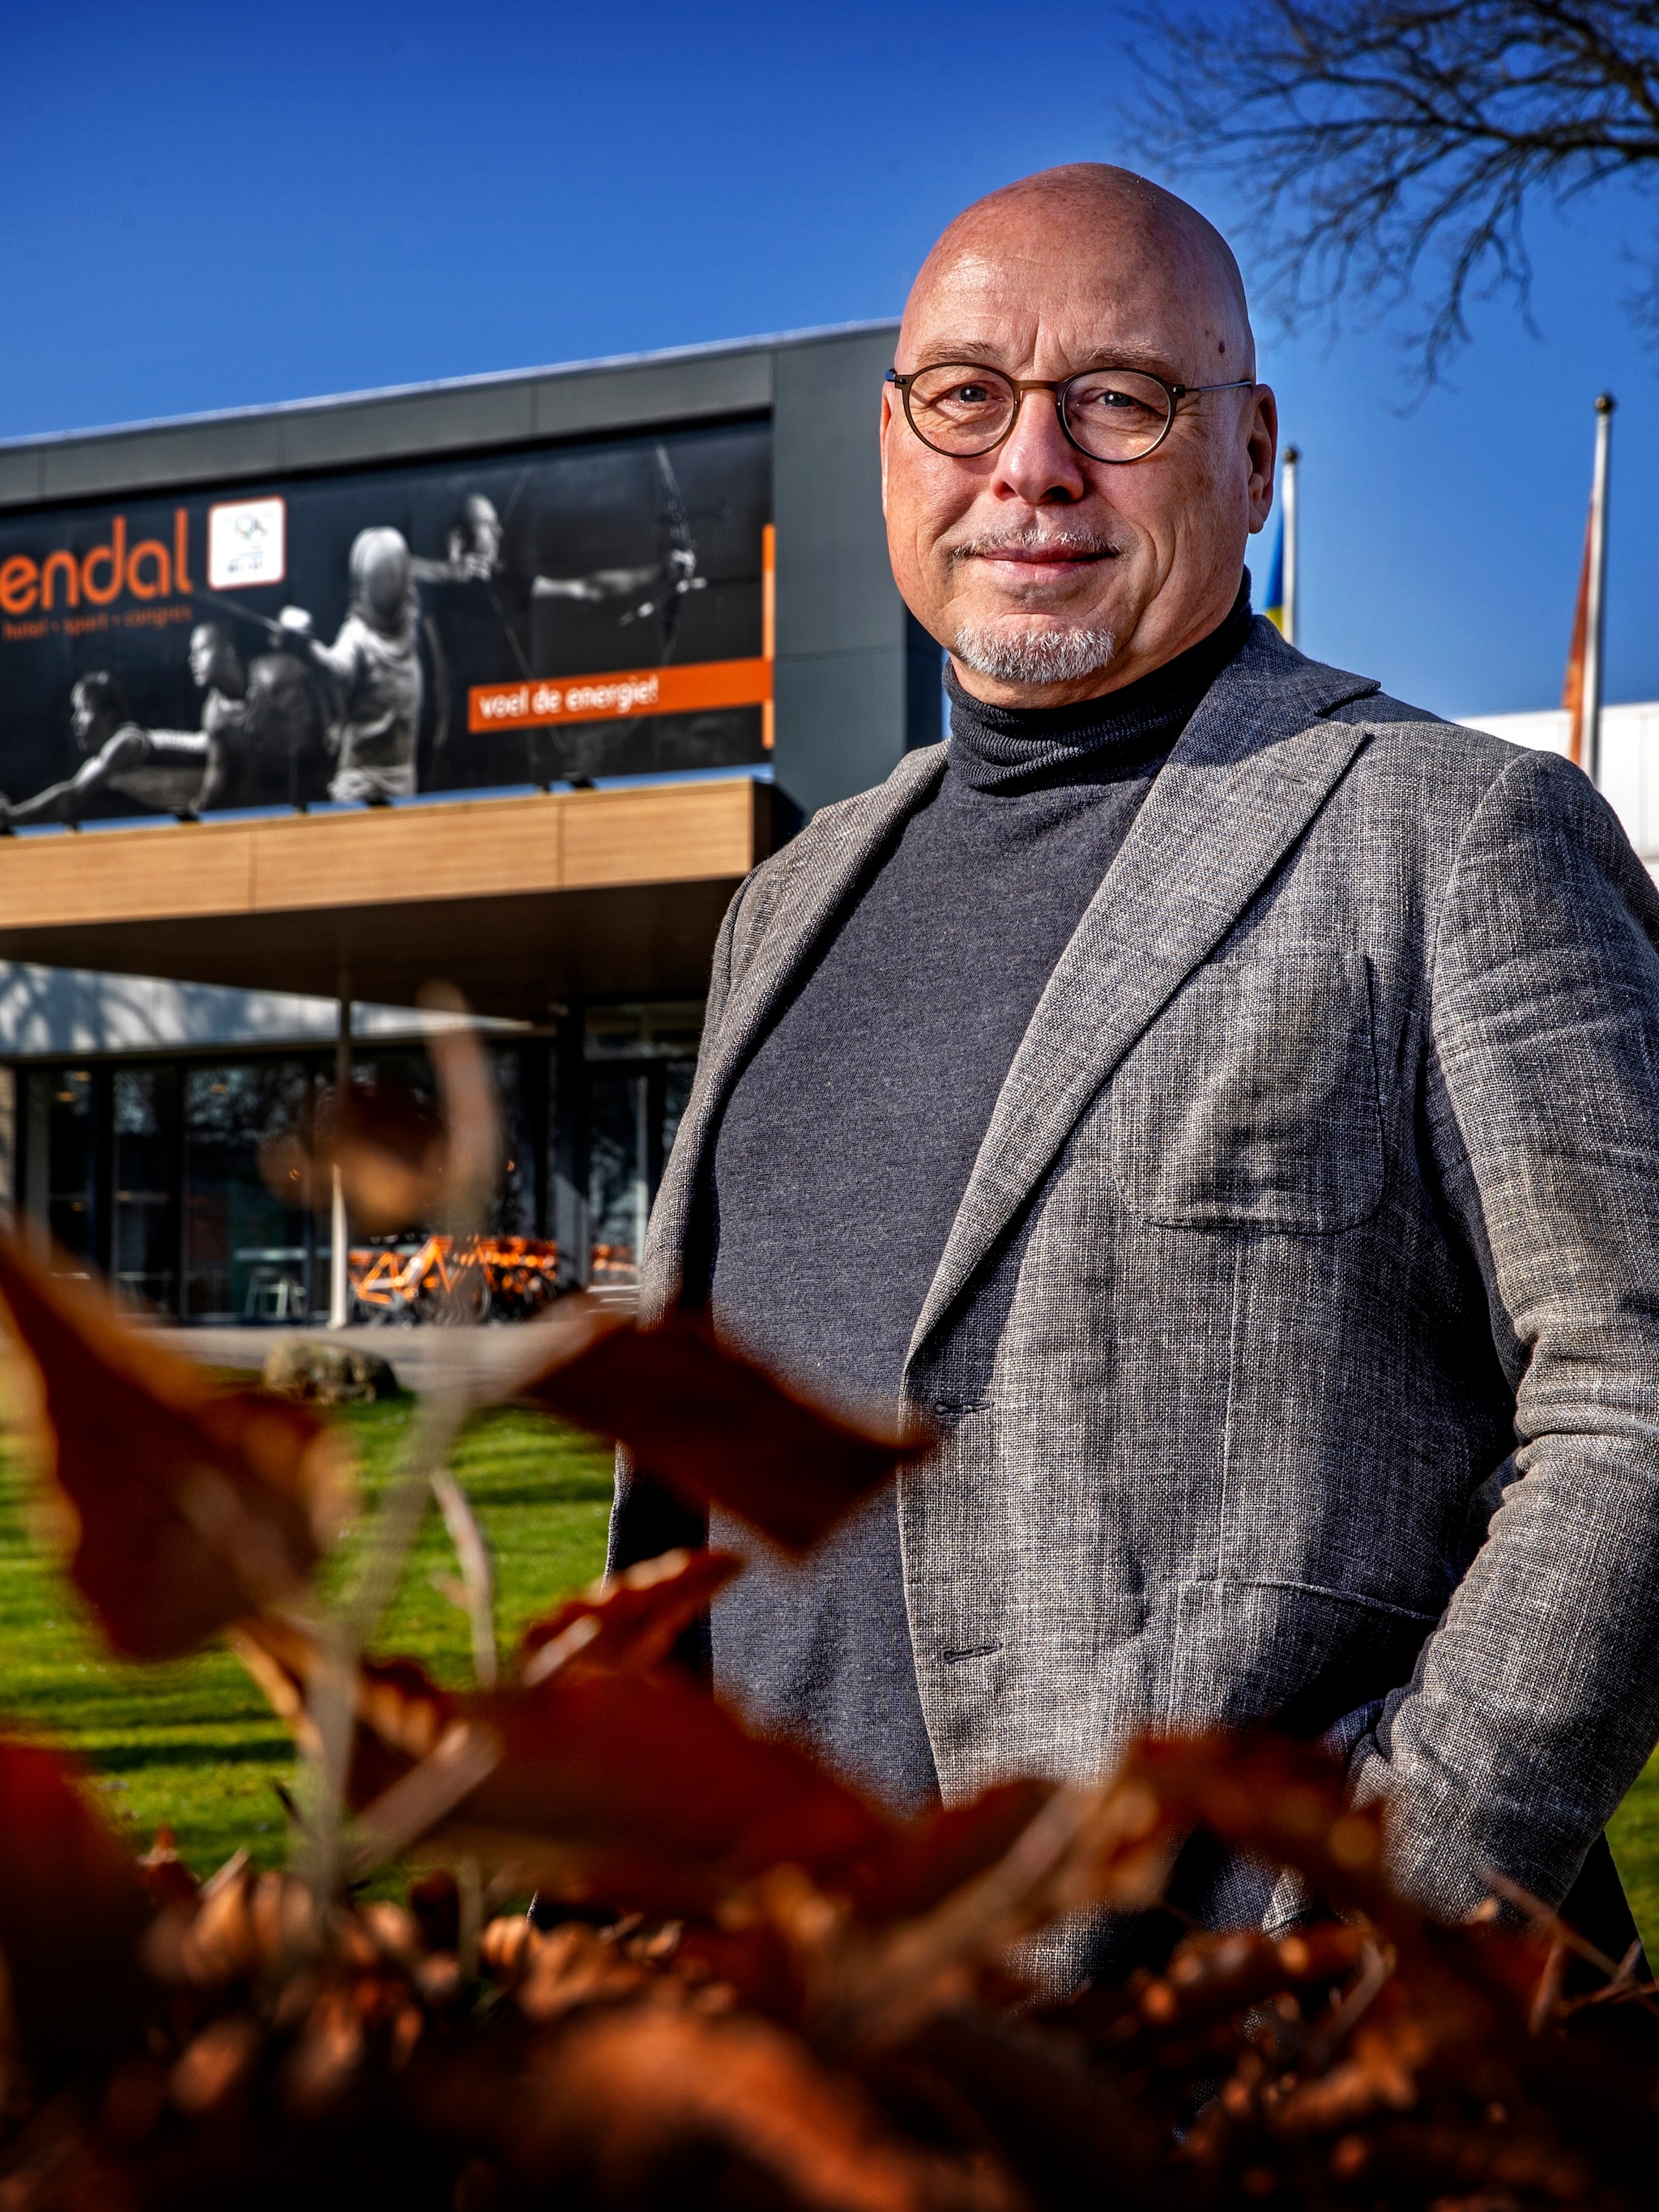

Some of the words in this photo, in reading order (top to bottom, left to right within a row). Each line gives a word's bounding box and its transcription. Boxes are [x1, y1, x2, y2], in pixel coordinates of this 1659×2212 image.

[0, 506, 193, 615] endal
[479, 685, 529, 719] voel
[531, 682, 562, 714] de
[565, 674, 659, 714] energie!
